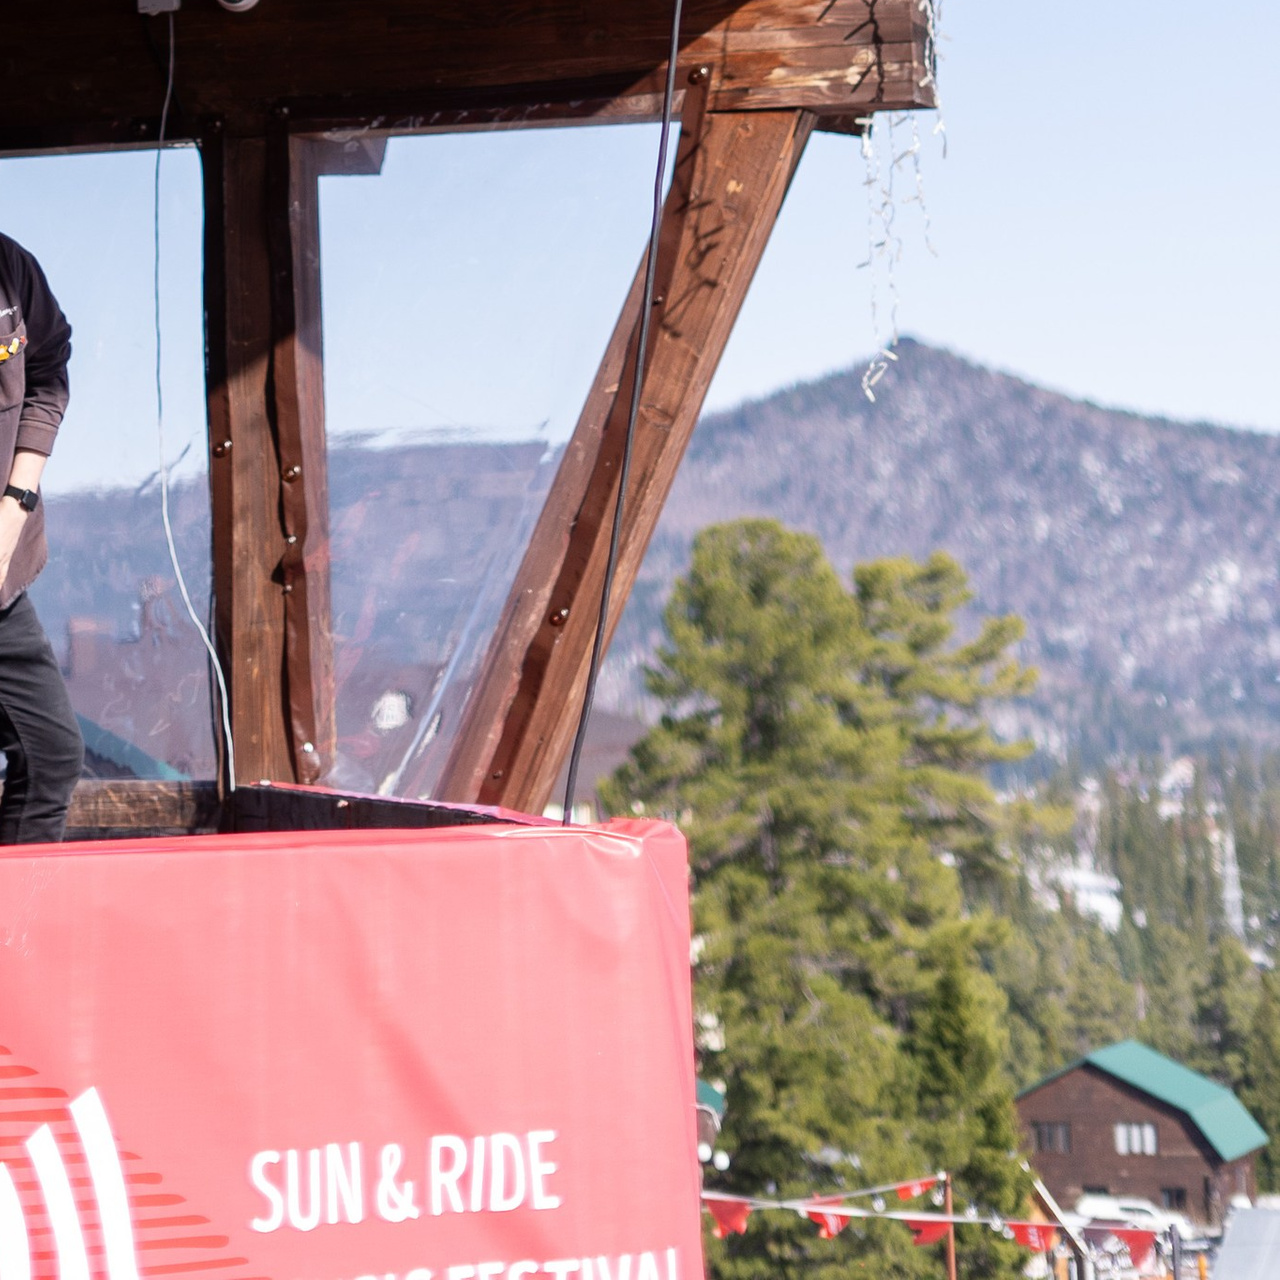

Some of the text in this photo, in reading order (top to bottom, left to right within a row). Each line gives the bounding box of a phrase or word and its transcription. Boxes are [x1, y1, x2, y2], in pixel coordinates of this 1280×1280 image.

[250, 1129, 562, 1233] SUN & RIDE
